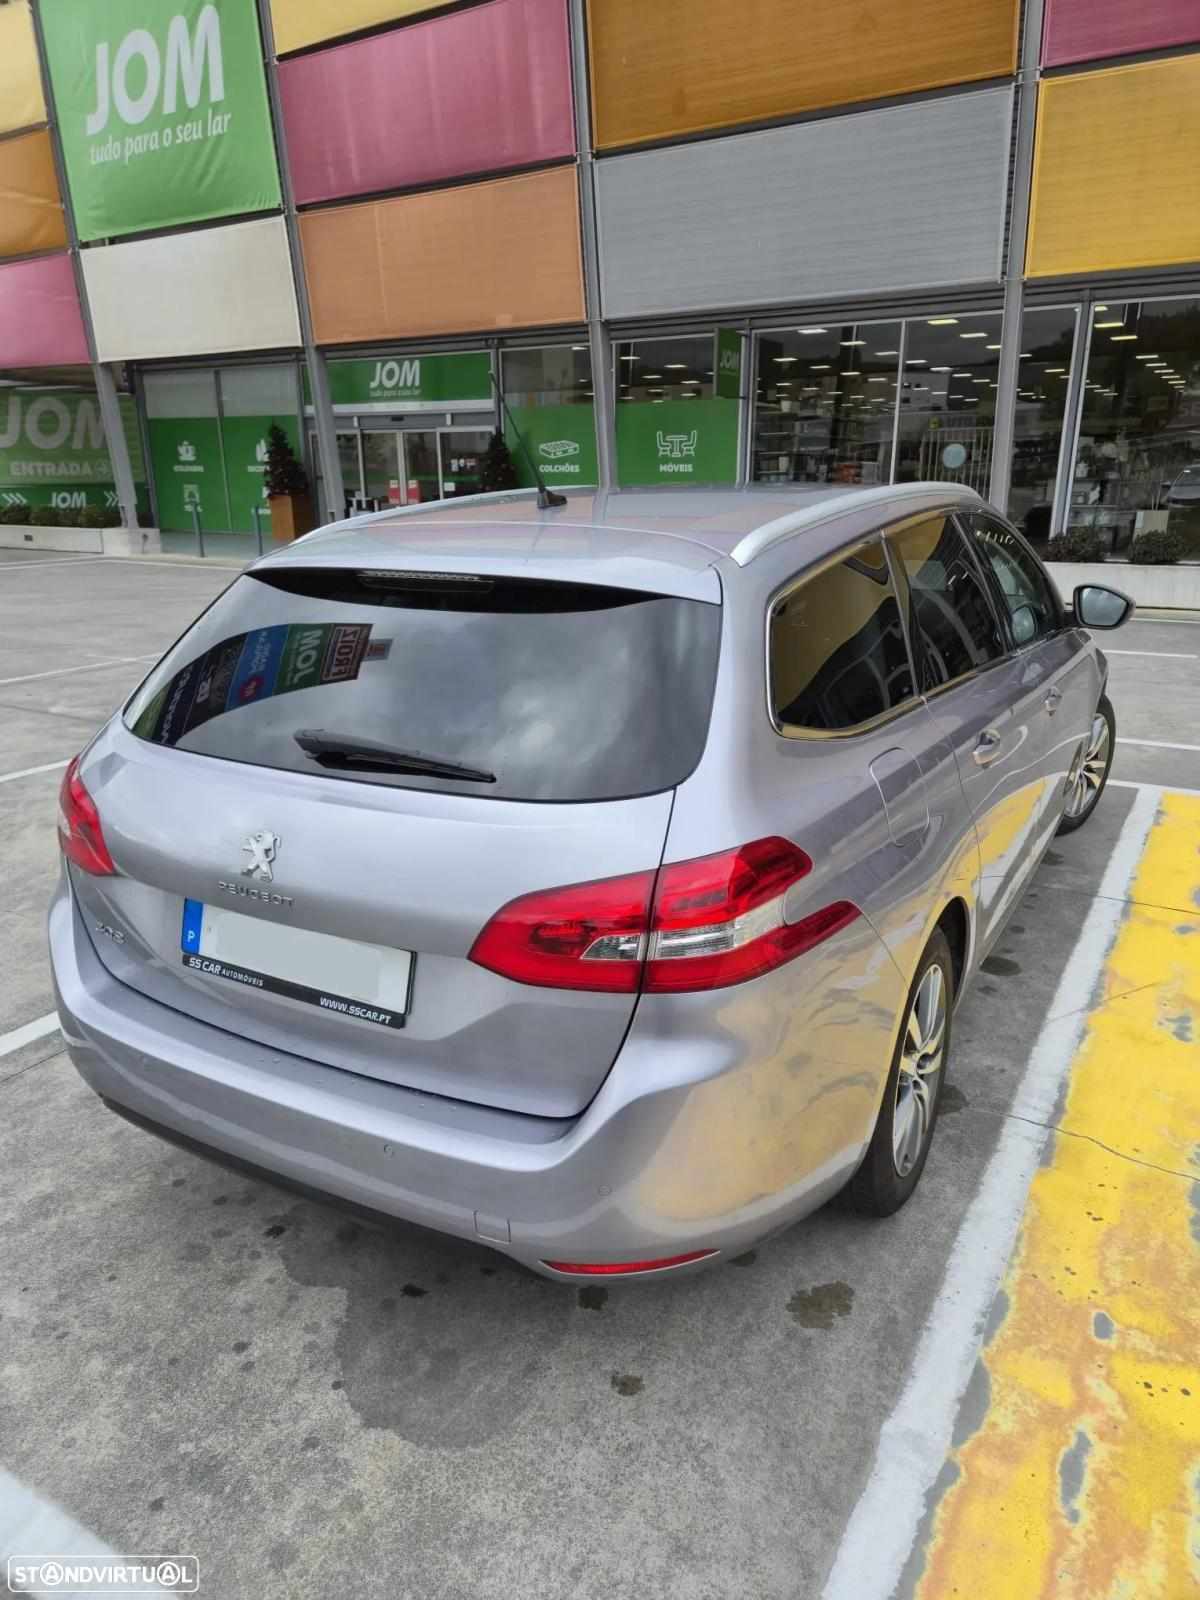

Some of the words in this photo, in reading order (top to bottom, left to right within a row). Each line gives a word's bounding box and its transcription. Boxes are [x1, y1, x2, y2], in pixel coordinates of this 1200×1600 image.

[86, 4, 225, 136] JOM
[90, 135, 121, 165] tudo
[125, 130, 160, 165] para
[163, 128, 172, 146] o
[176, 119, 203, 144] seu
[207, 108, 232, 137] lar
[369, 359, 421, 389] JOM
[10, 460, 94, 476] ENTRADA
[539, 462, 580, 473] COLCHÕES
[659, 461, 693, 473] MÓVEIS
[50, 491, 87, 508] JOM
[218, 880, 296, 908] PEUGEOT
[187, 930, 196, 943] P
[189, 957, 202, 969] SS
[202, 961, 221, 975] CAR
[319, 996, 392, 1025] WWW.SSCAR.PT
